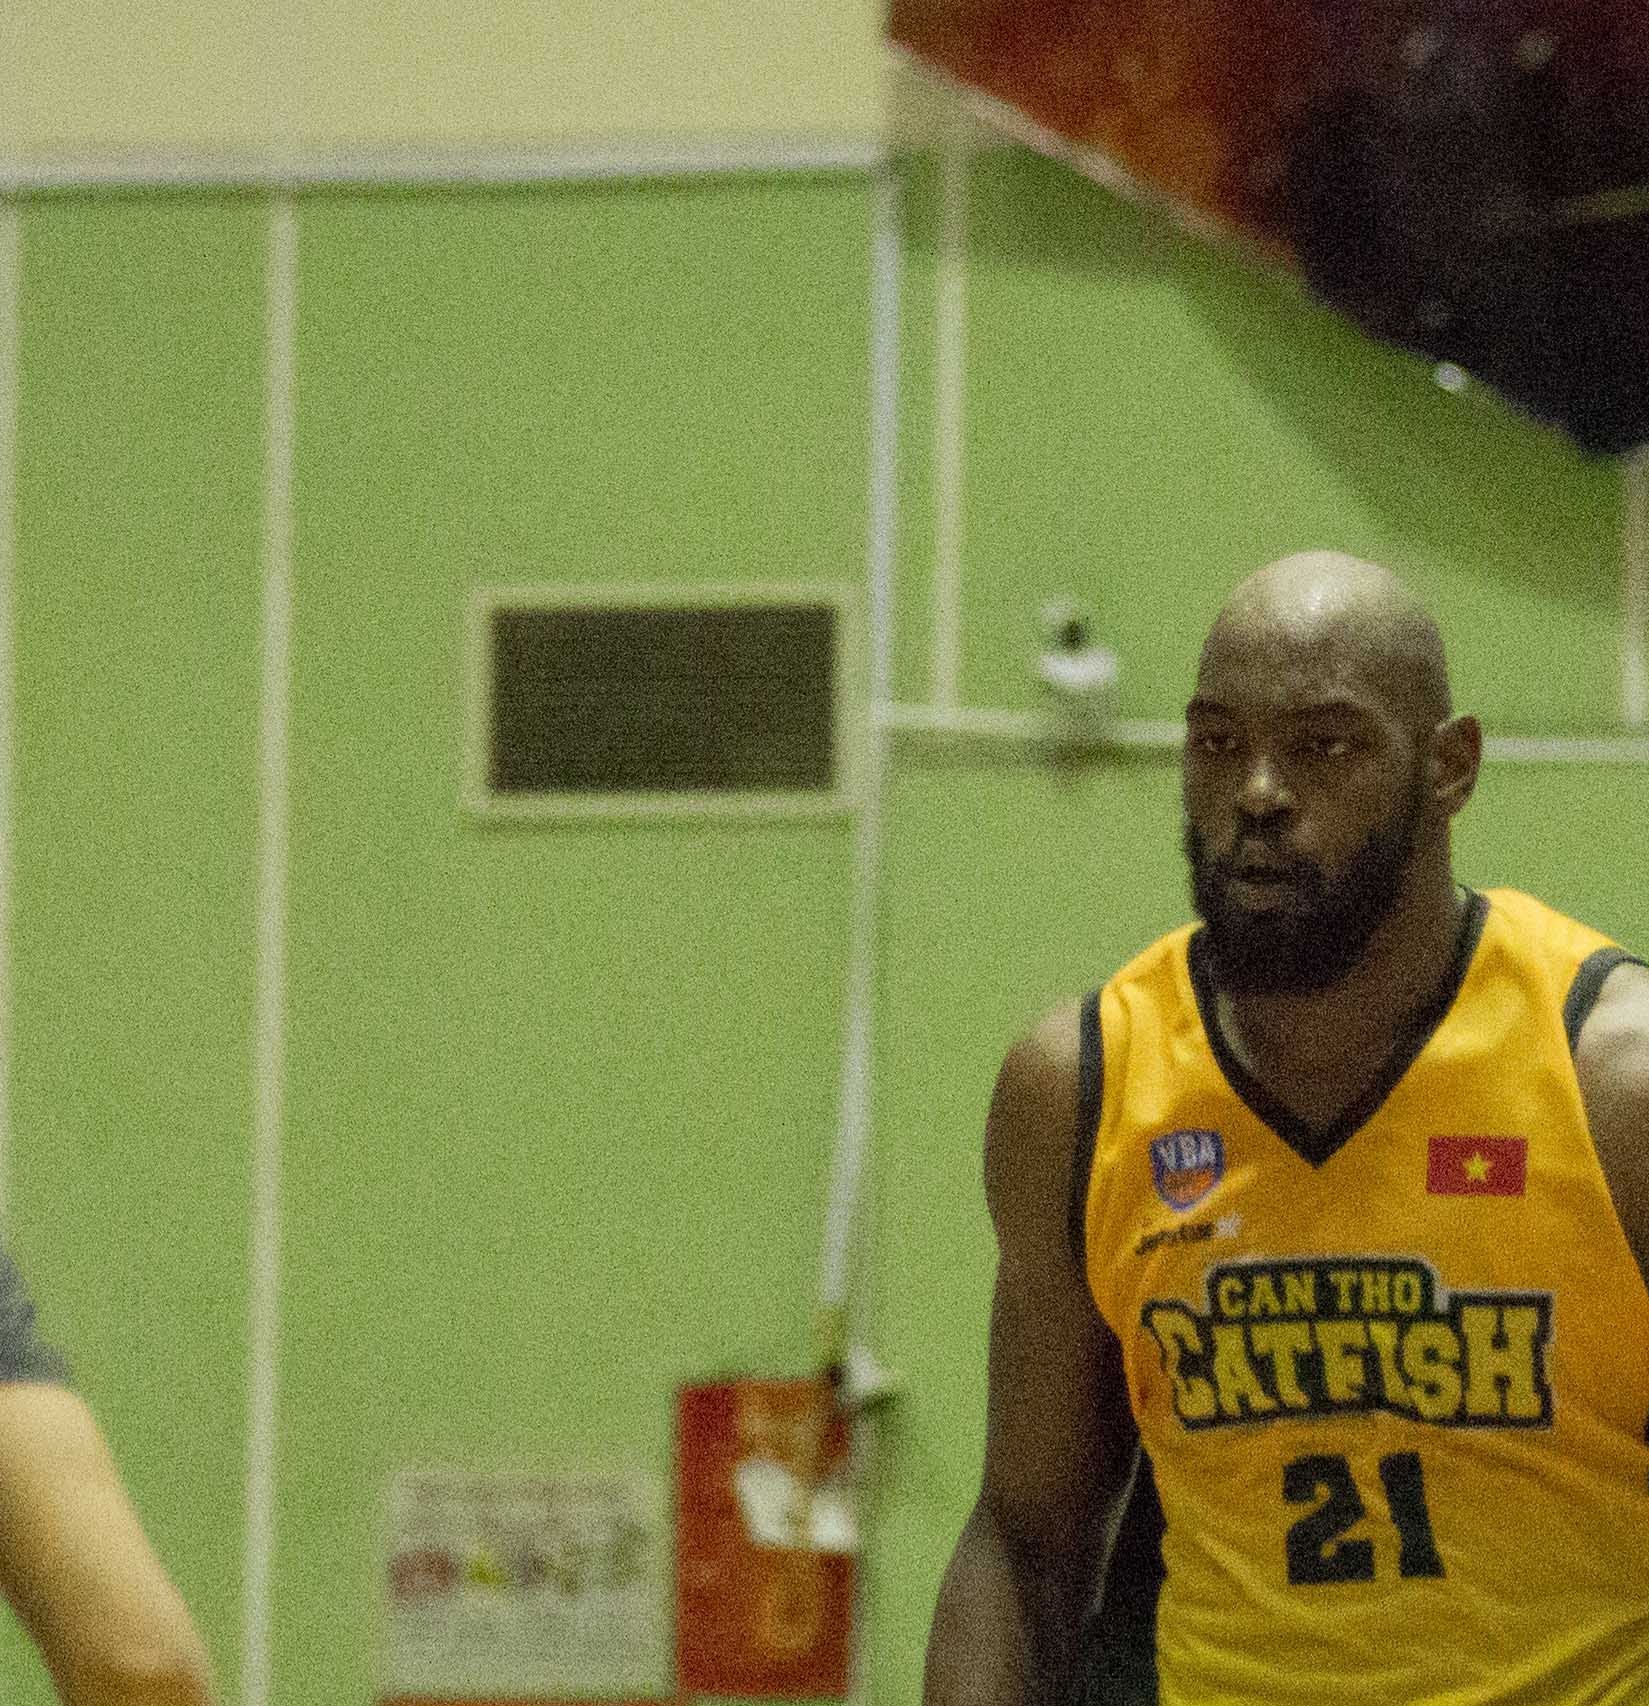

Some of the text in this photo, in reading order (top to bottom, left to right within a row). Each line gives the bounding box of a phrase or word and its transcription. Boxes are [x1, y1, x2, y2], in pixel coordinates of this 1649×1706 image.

[1156, 1132, 1217, 1171] VBA
[1215, 1269, 1423, 1318] CAN THO
[1148, 1302, 1546, 1420] CATFISH
[1281, 1451, 1447, 1585] 21
